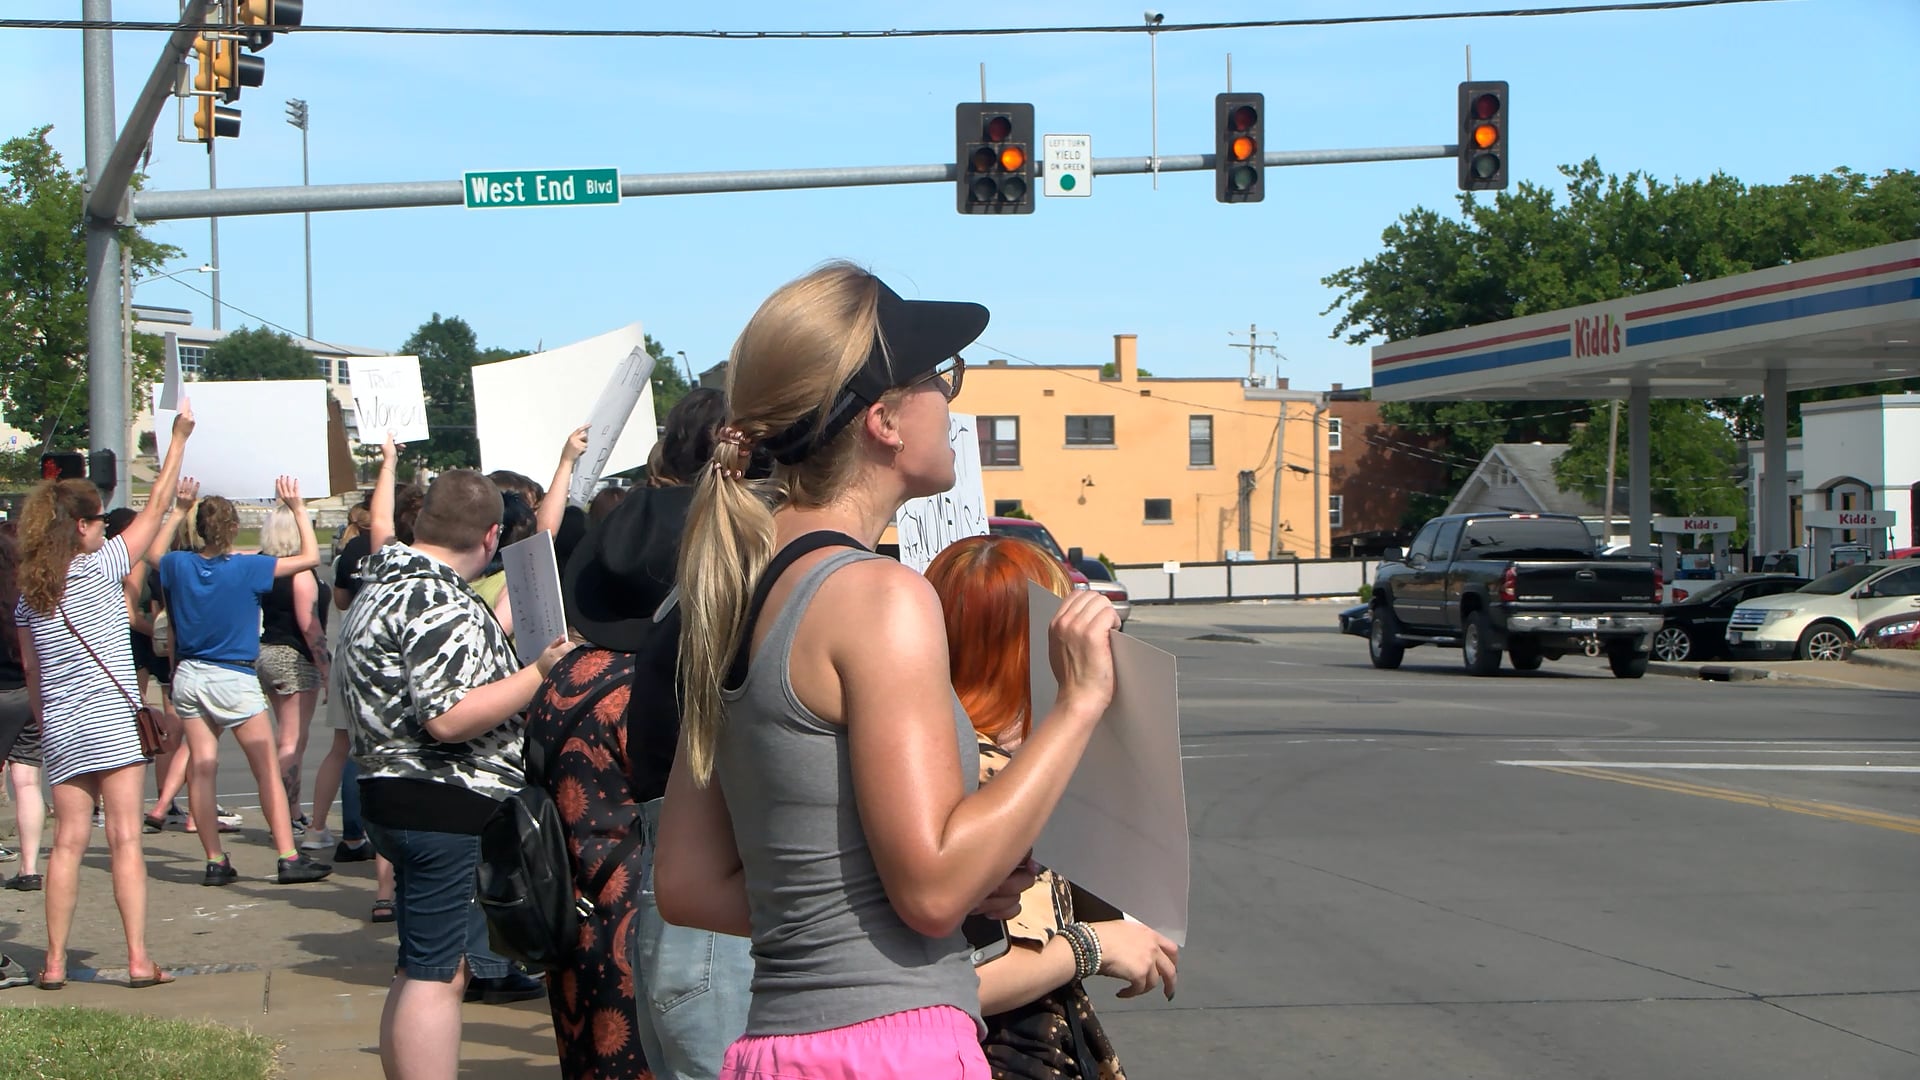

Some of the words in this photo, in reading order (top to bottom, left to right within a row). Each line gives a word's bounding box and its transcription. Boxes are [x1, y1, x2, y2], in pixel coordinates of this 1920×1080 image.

[1056, 150, 1081, 160] YIELD
[471, 176, 526, 203] West
[535, 175, 576, 201] End
[586, 179, 612, 195] Blvd
[1574, 312, 1620, 359] Kidd's
[1839, 513, 1877, 524] Kidd's
[1684, 519, 1719, 530] Kidd's
[1720, 548, 1727, 558] 5
